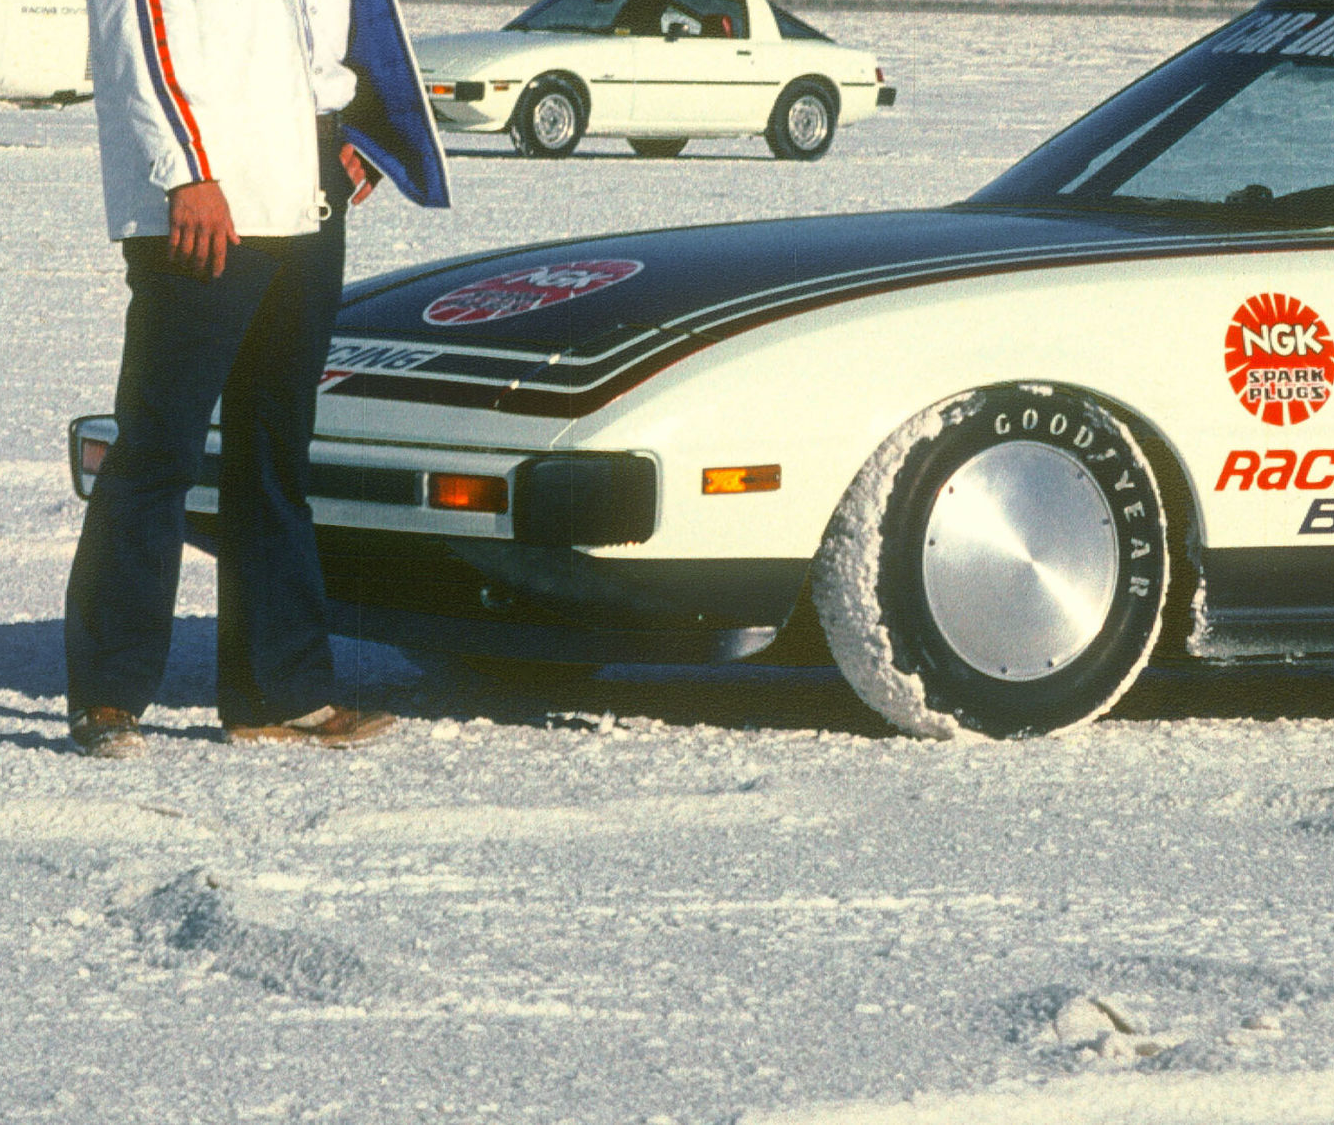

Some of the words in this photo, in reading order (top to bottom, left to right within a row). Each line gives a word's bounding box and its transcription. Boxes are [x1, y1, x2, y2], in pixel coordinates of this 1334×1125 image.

[1242, 322, 1323, 356] NGK
[1248, 368, 1324, 385] SPARK
[1248, 385, 1324, 403] PLUGS
[994, 409, 1150, 598] GOODYEAR
